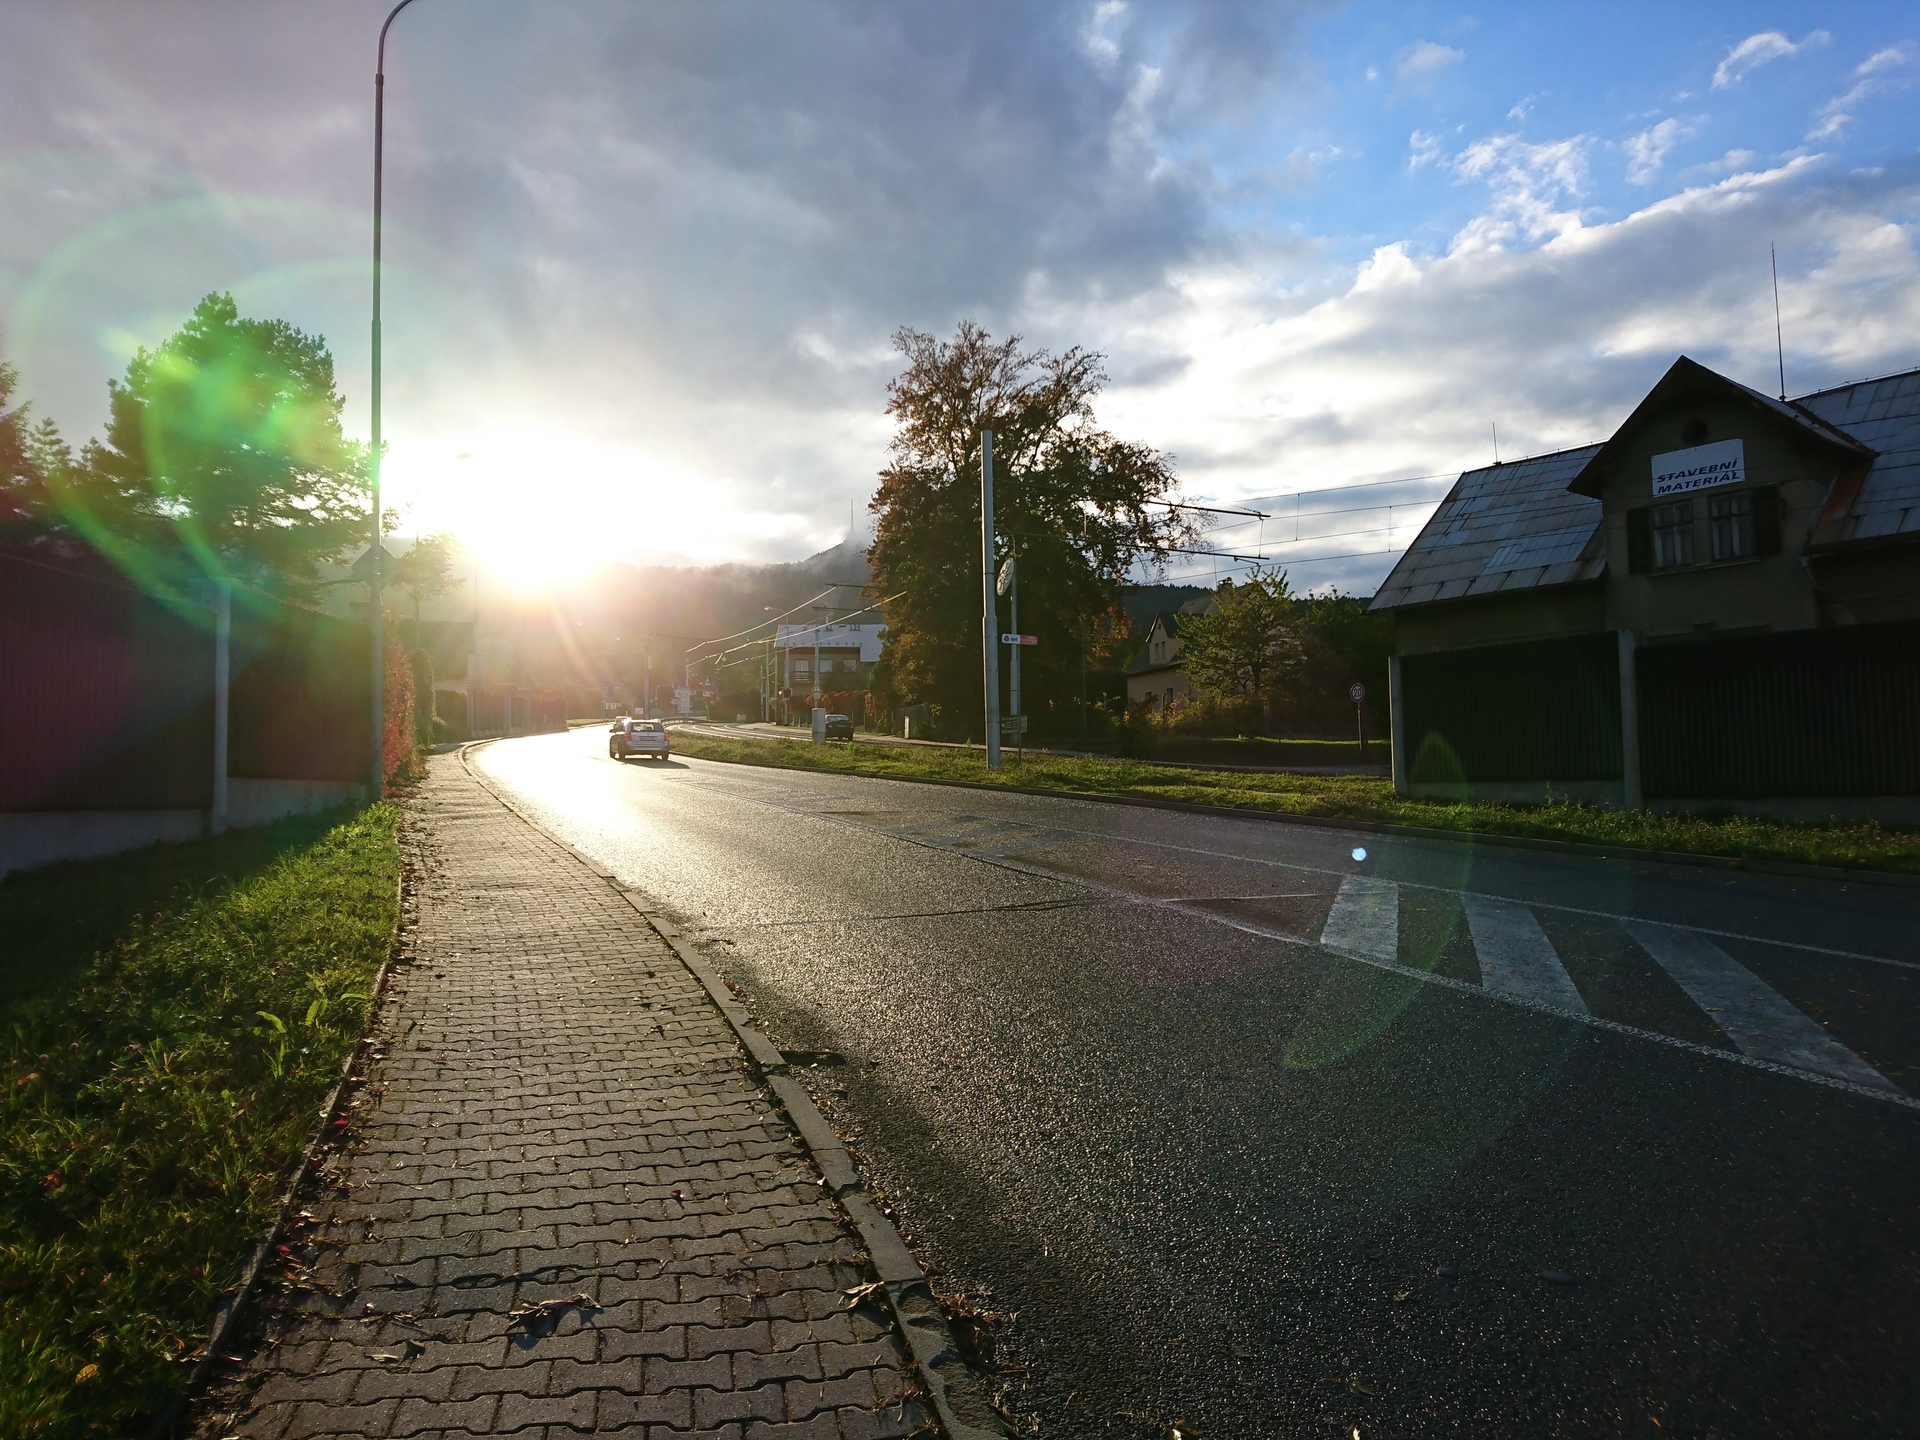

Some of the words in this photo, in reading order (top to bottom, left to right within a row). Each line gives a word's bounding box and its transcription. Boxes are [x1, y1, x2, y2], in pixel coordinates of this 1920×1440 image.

[1657, 458, 1738, 483] STAVEBNÍ
[1658, 471, 1740, 493] MATERIÁL
[1354, 688, 1361, 697] 20
